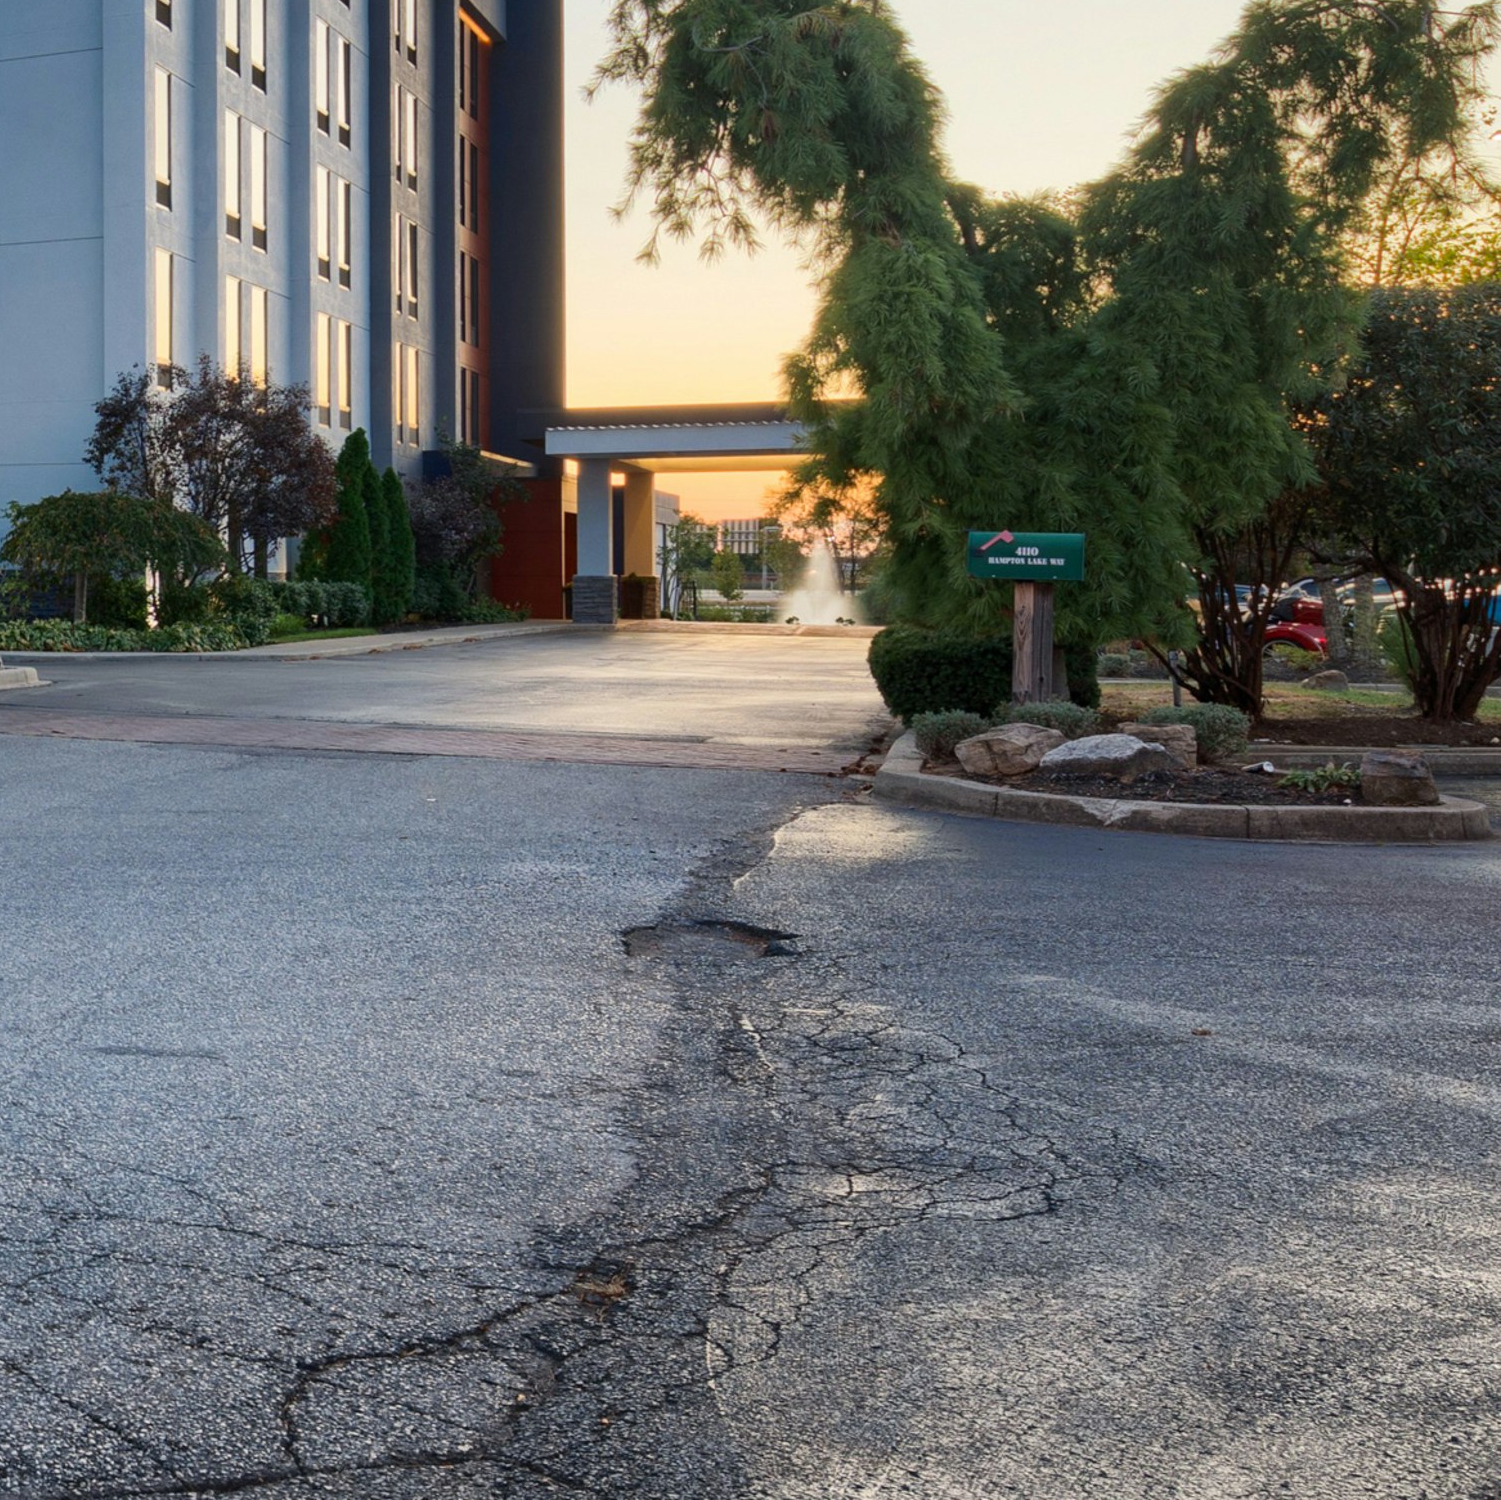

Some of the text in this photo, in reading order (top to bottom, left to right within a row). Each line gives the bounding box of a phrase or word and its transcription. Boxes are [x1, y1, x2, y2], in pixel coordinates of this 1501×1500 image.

[1015, 546, 1039, 556] 4110
[988, 556, 1026, 564] HAMPTON
[1027, 557, 1047, 565] LAKE
